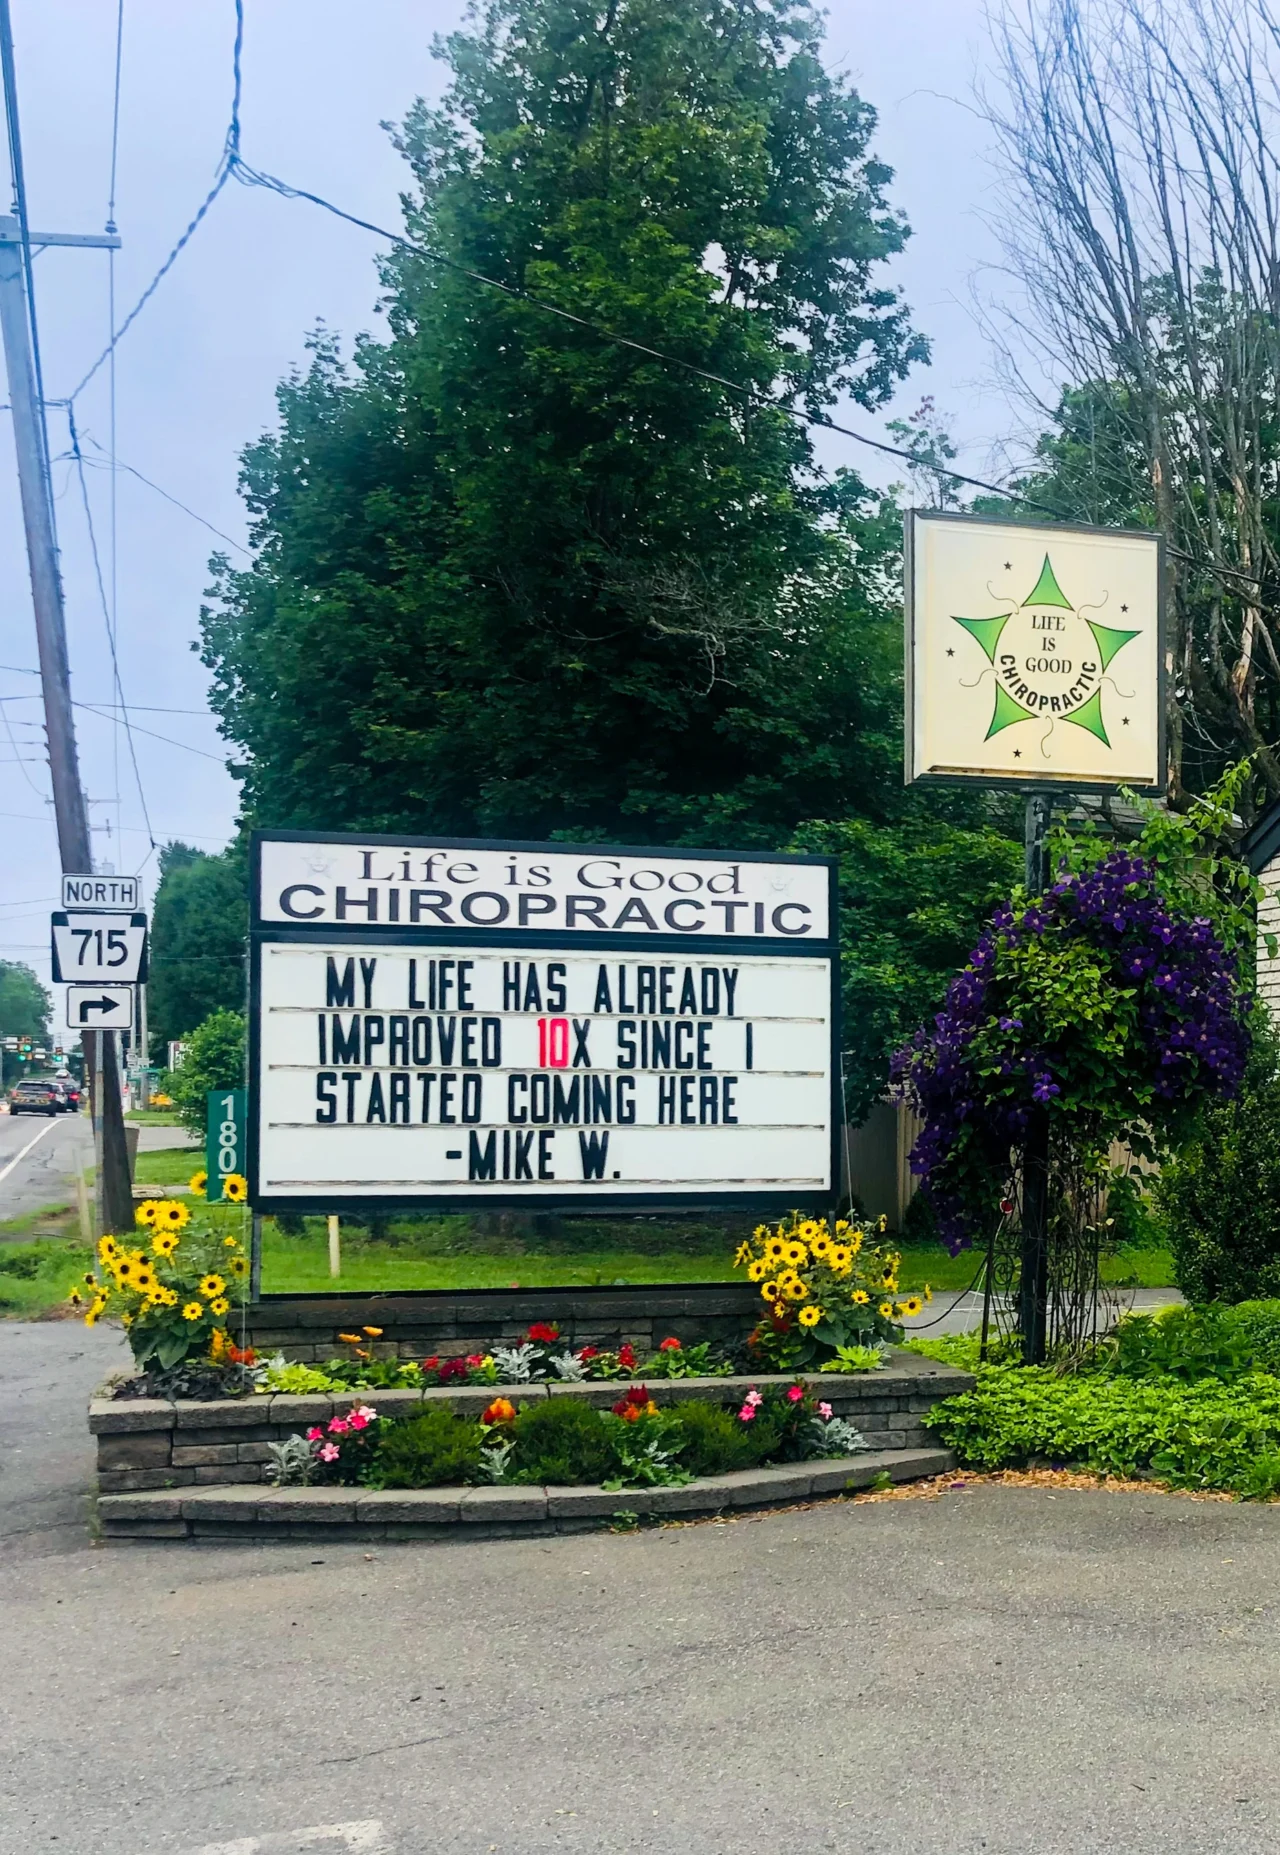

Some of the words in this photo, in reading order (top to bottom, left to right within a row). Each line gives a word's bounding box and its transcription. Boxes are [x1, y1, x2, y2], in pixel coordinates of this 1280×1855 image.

[1032, 614, 1066, 631] LIFE
[1042, 636, 1056, 651] IS
[1000, 654, 1097, 712] CHIROPRACTIC
[1026, 657, 1072, 674] GOOD
[67, 881, 133, 903] NORTH
[358, 850, 480, 884] Life
[504, 856, 552, 887] is
[577, 860, 745, 895] Good
[279, 884, 812, 935] CHIROPRACTIC
[71, 929, 129, 967] 715
[326, 957, 377, 1008] MY
[409, 959, 474, 1011] LIFE
[503, 961, 566, 1012] HAS
[594, 964, 738, 1016] ALREADY
[318, 1014, 501, 1067] IMPROVED
[538, 1018, 591, 1068] 10X
[617, 1020, 713, 1070] SINCE
[746, 1022, 753, 1070] I
[316, 1072, 482, 1124] STARTED
[508, 1074, 636, 1124] COMING
[659, 1076, 738, 1125] HERE
[446, 1130, 555, 1180] -MIKE
[579, 1130, 620, 1179] W.
